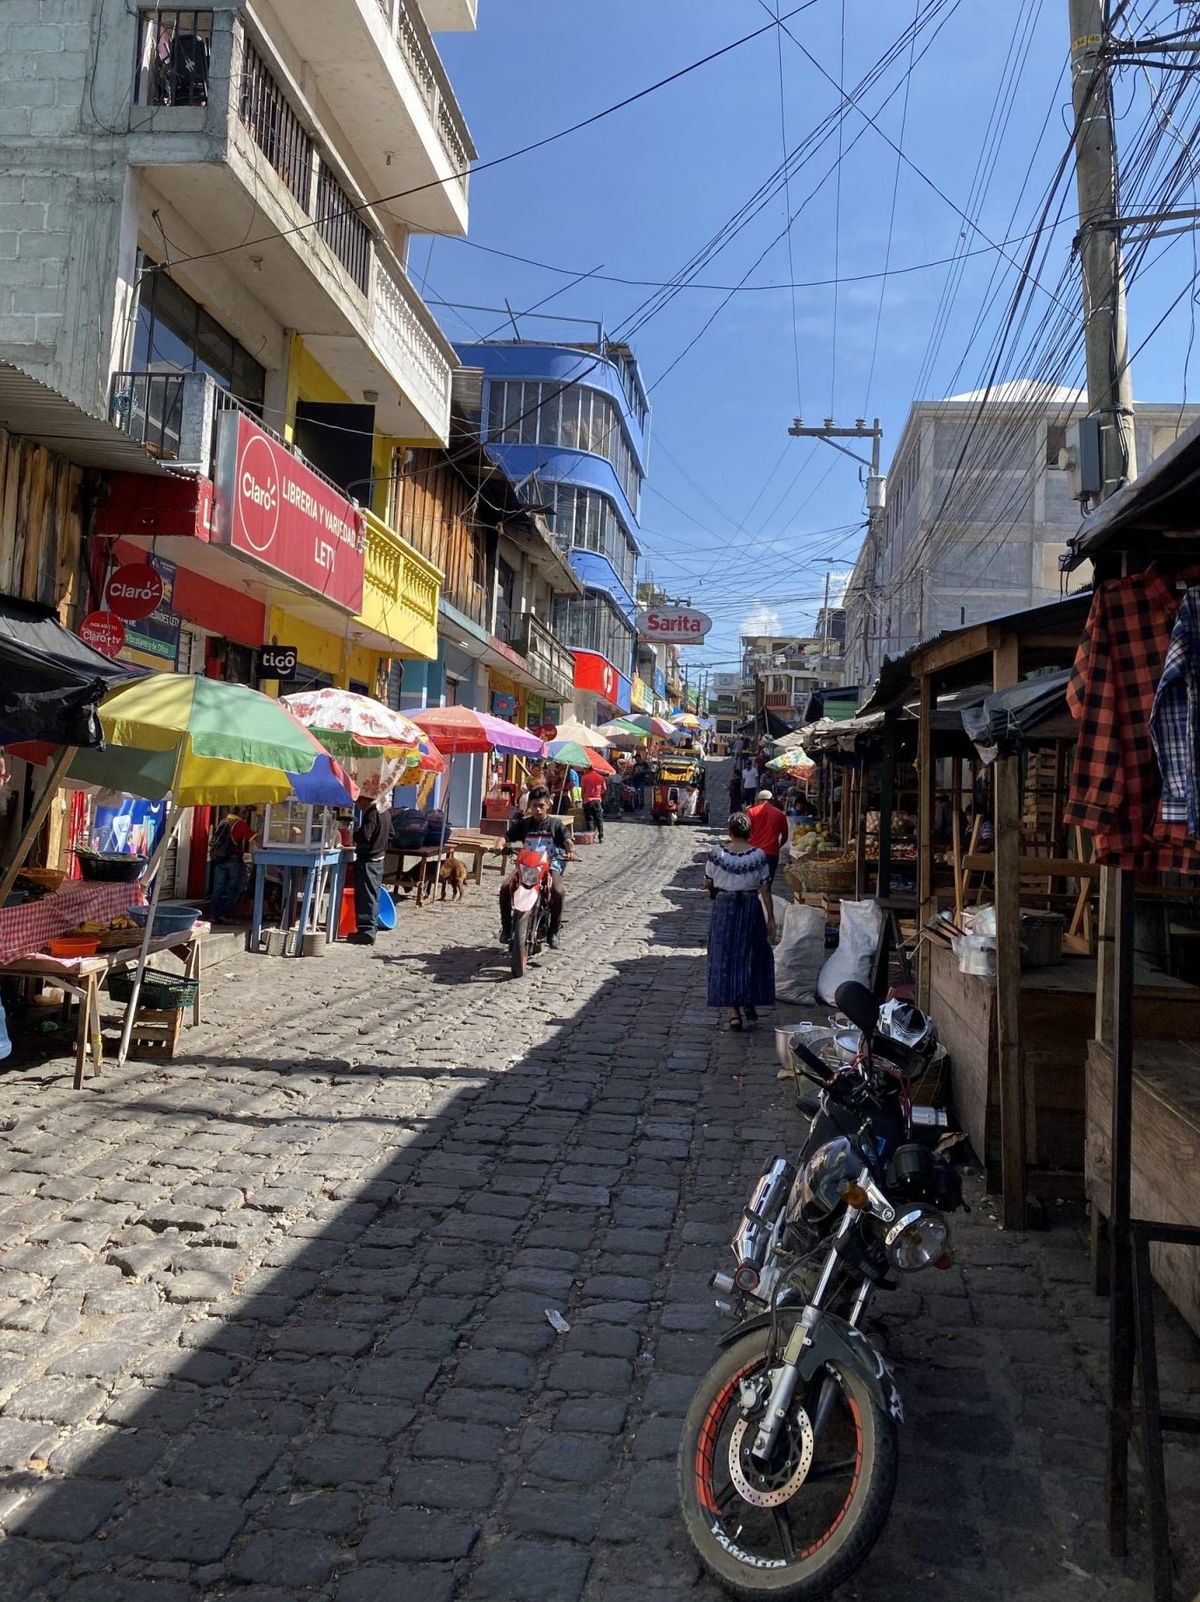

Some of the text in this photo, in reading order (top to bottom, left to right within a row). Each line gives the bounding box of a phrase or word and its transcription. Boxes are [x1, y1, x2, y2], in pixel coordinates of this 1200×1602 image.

[242, 471, 273, 511] Claro
[282, 475, 318, 522] LIBRERIA
[319, 508, 325, 526] Y
[314, 537, 336, 573] LETY
[110, 582, 153, 600] Claro
[83, 630, 107, 643] Claro
[647, 614, 701, 632] Sarita
[711, 1521, 787, 1569] YAMAHA
